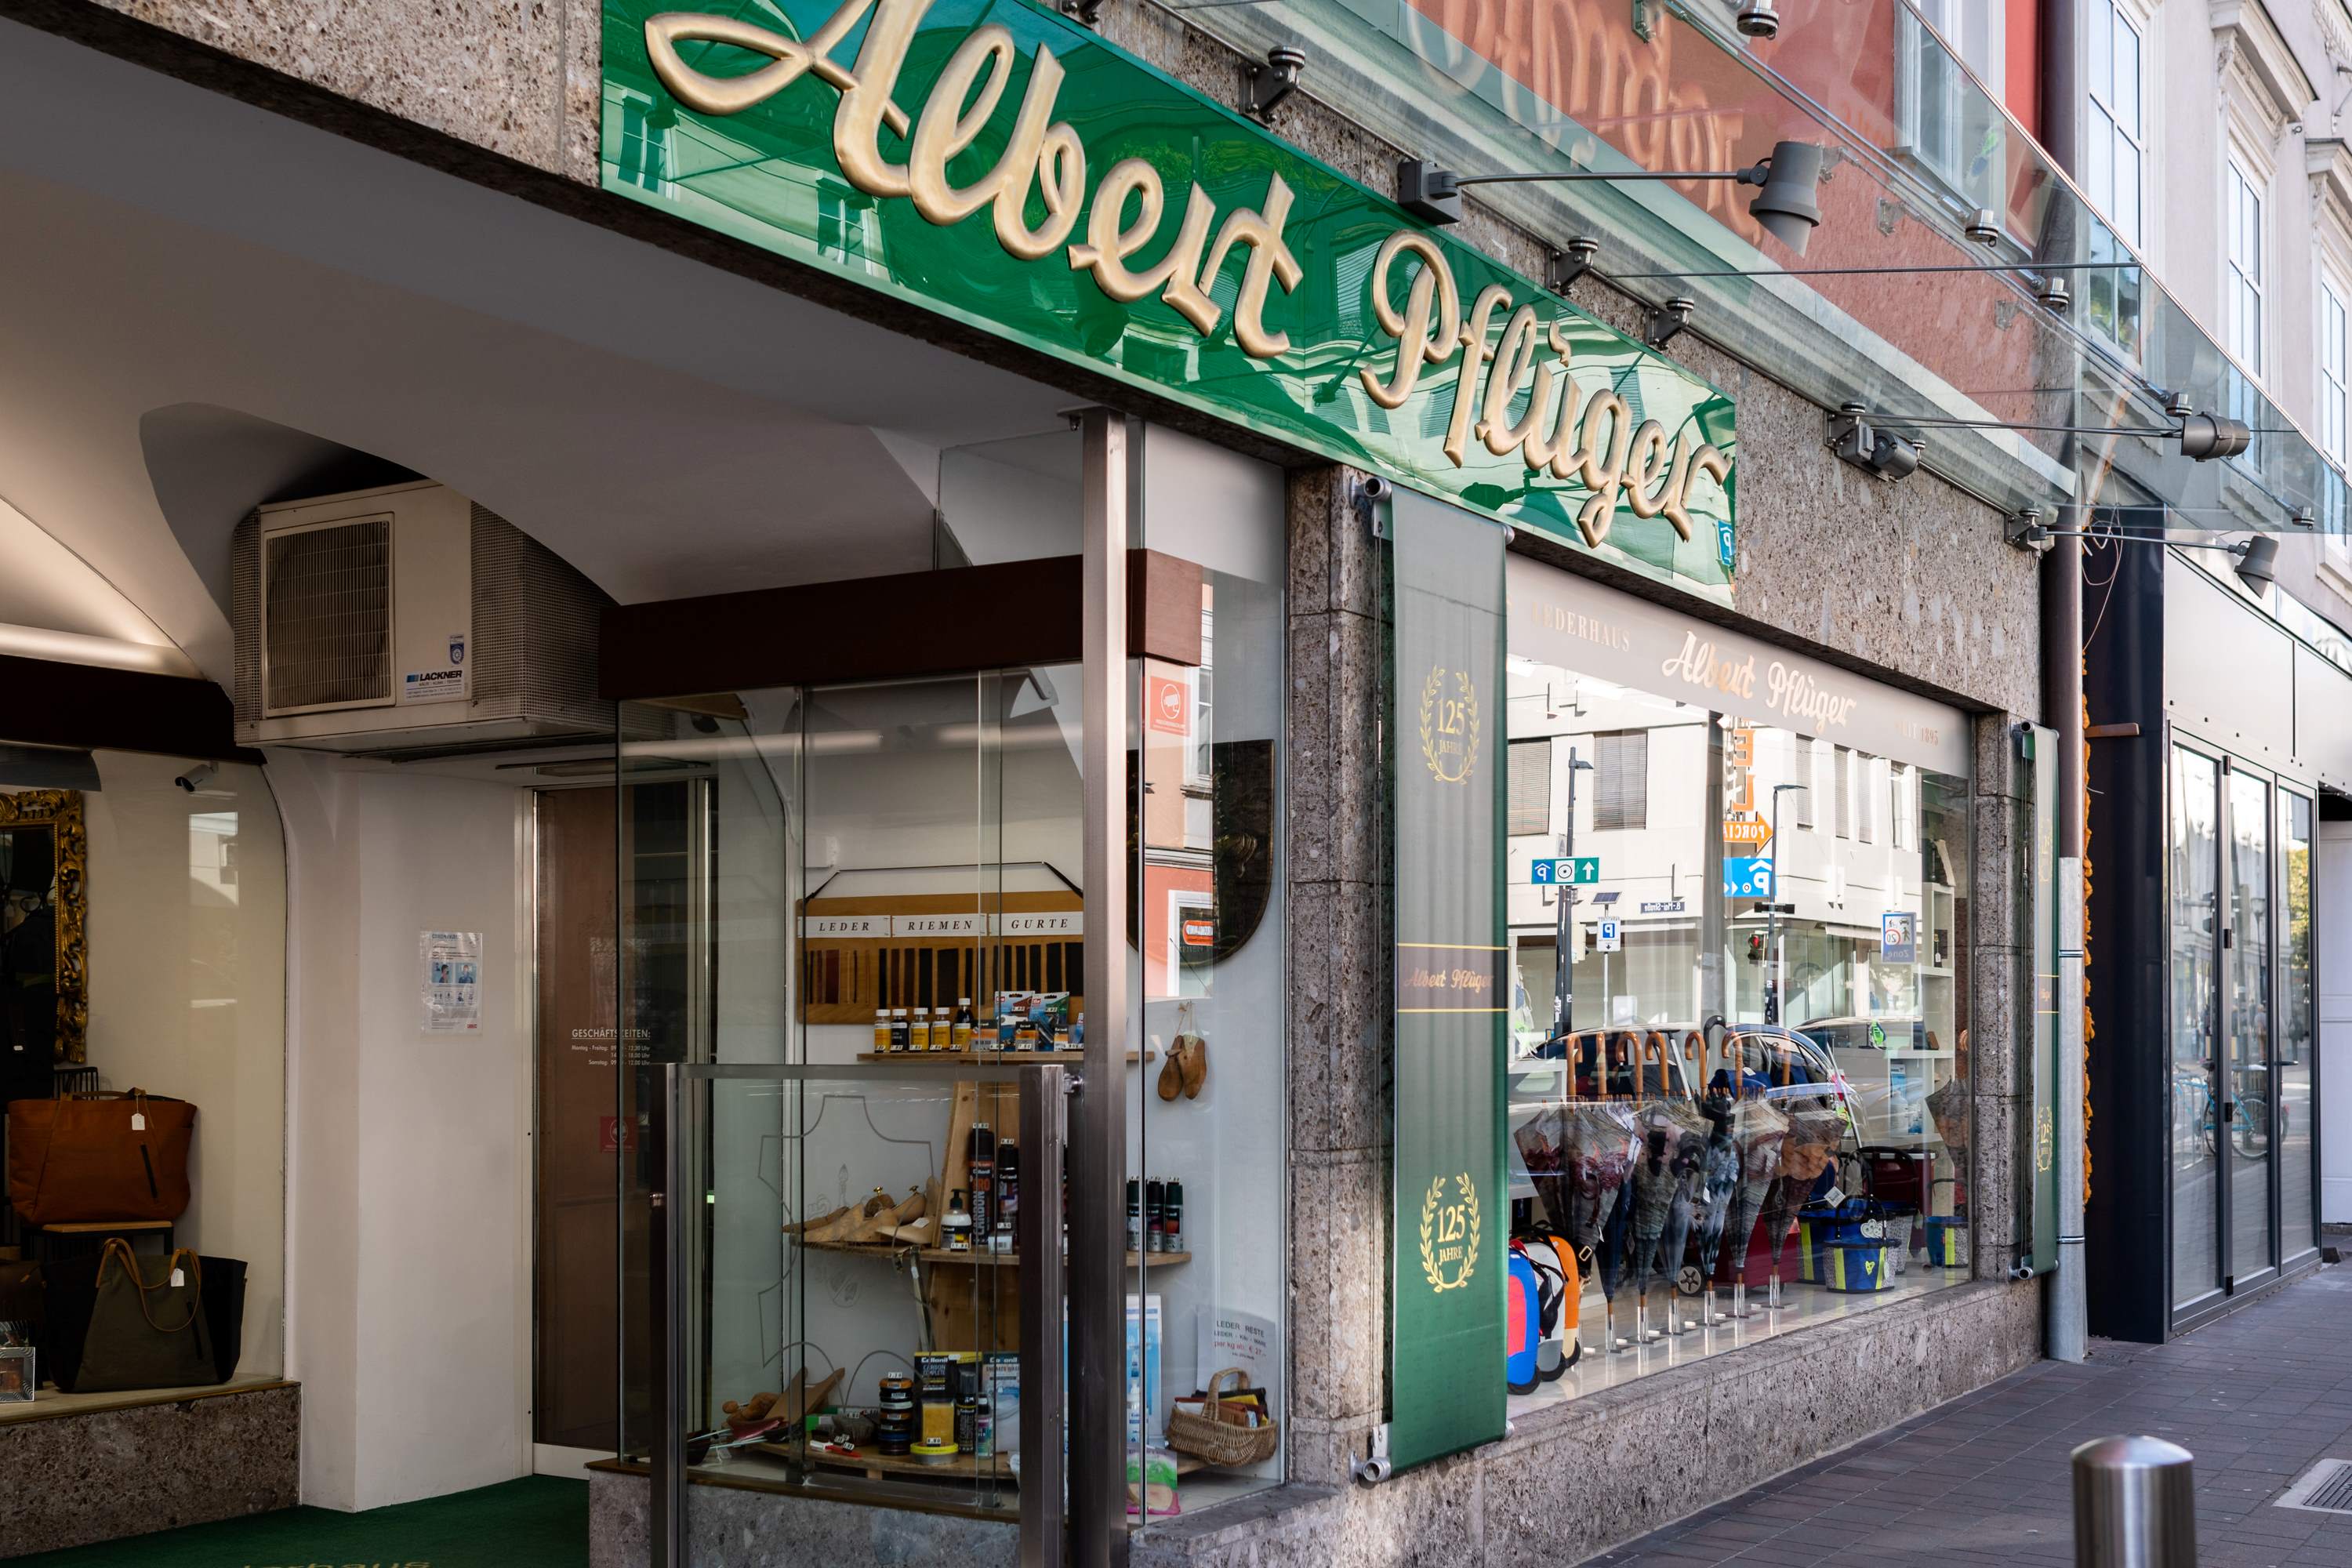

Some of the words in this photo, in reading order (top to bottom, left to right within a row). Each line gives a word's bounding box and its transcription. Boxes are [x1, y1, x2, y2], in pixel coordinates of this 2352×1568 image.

[644, 0, 1302, 358] Albert
[1360, 229, 1732, 548] Pflüger
[419, 670, 463, 681] LACKNER
[1531, 601, 1631, 652] LEDERHAUS
[1661, 630, 1757, 699] Albert
[1767, 661, 1857, 736] Pflüger
[1437, 699, 1465, 735] 125
[1438, 739, 1464, 755] JAHRE
[818, 920, 871, 932] LEDER
[907, 919, 974, 931] RIEMEN
[1011, 918, 1069, 929] GURTE
[1405, 967, 1446, 988] Albert
[572, 1027, 651, 1038] GESCHÄFTSEITEN:
[1437, 1204, 1466, 1243] 125
[1439, 1245, 1464, 1265] JAHRE
[1216, 1319, 1240, 1330] LEDER
[1245, 1325, 1265, 1338] RESTE
